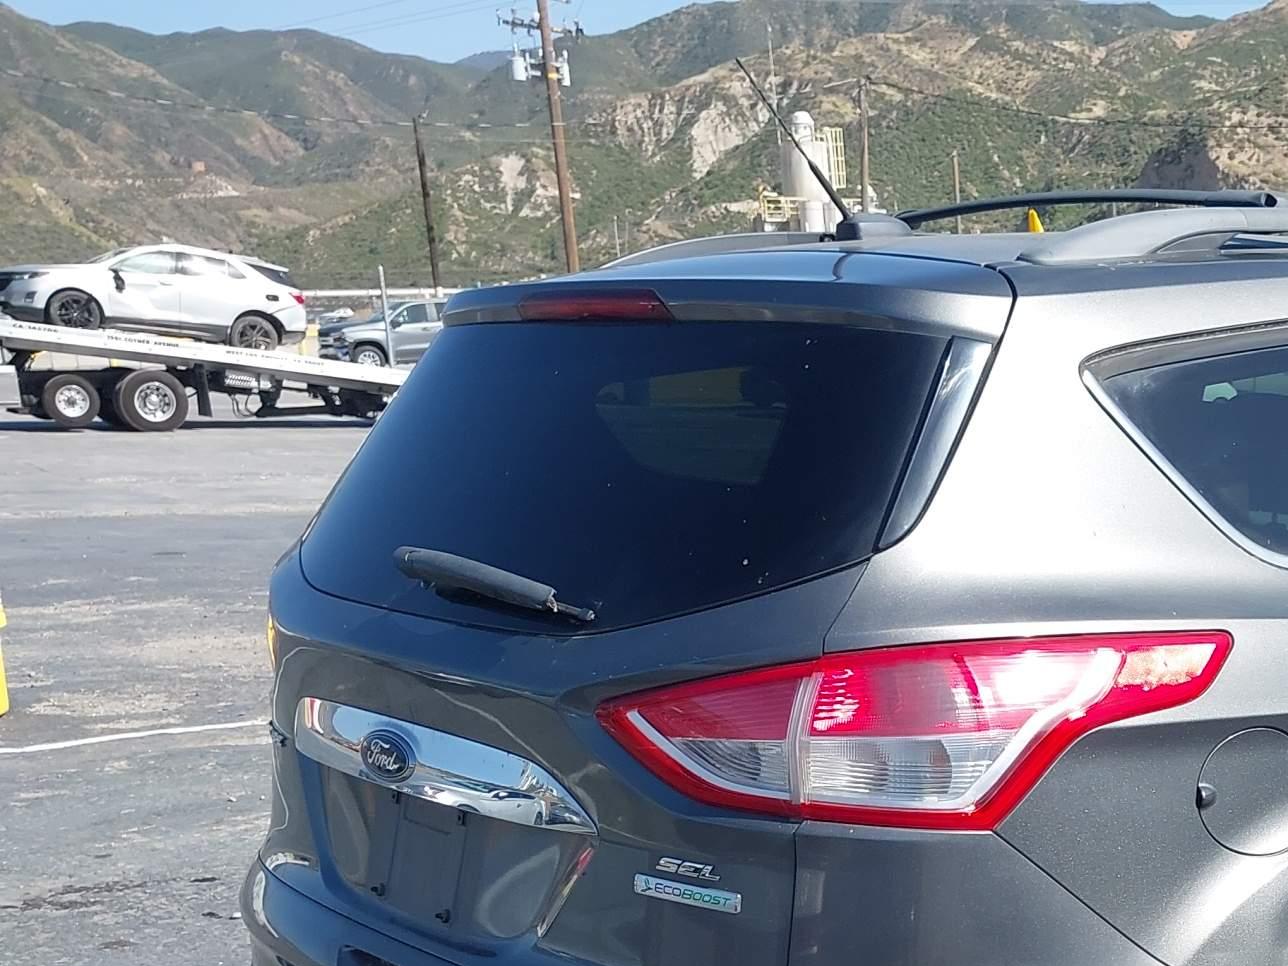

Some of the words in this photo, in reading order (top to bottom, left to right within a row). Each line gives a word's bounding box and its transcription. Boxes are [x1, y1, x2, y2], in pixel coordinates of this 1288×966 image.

[367, 739, 400, 770] Ford
[655, 857, 721, 881] SEL
[654, 882, 732, 907] ECOBOOST
